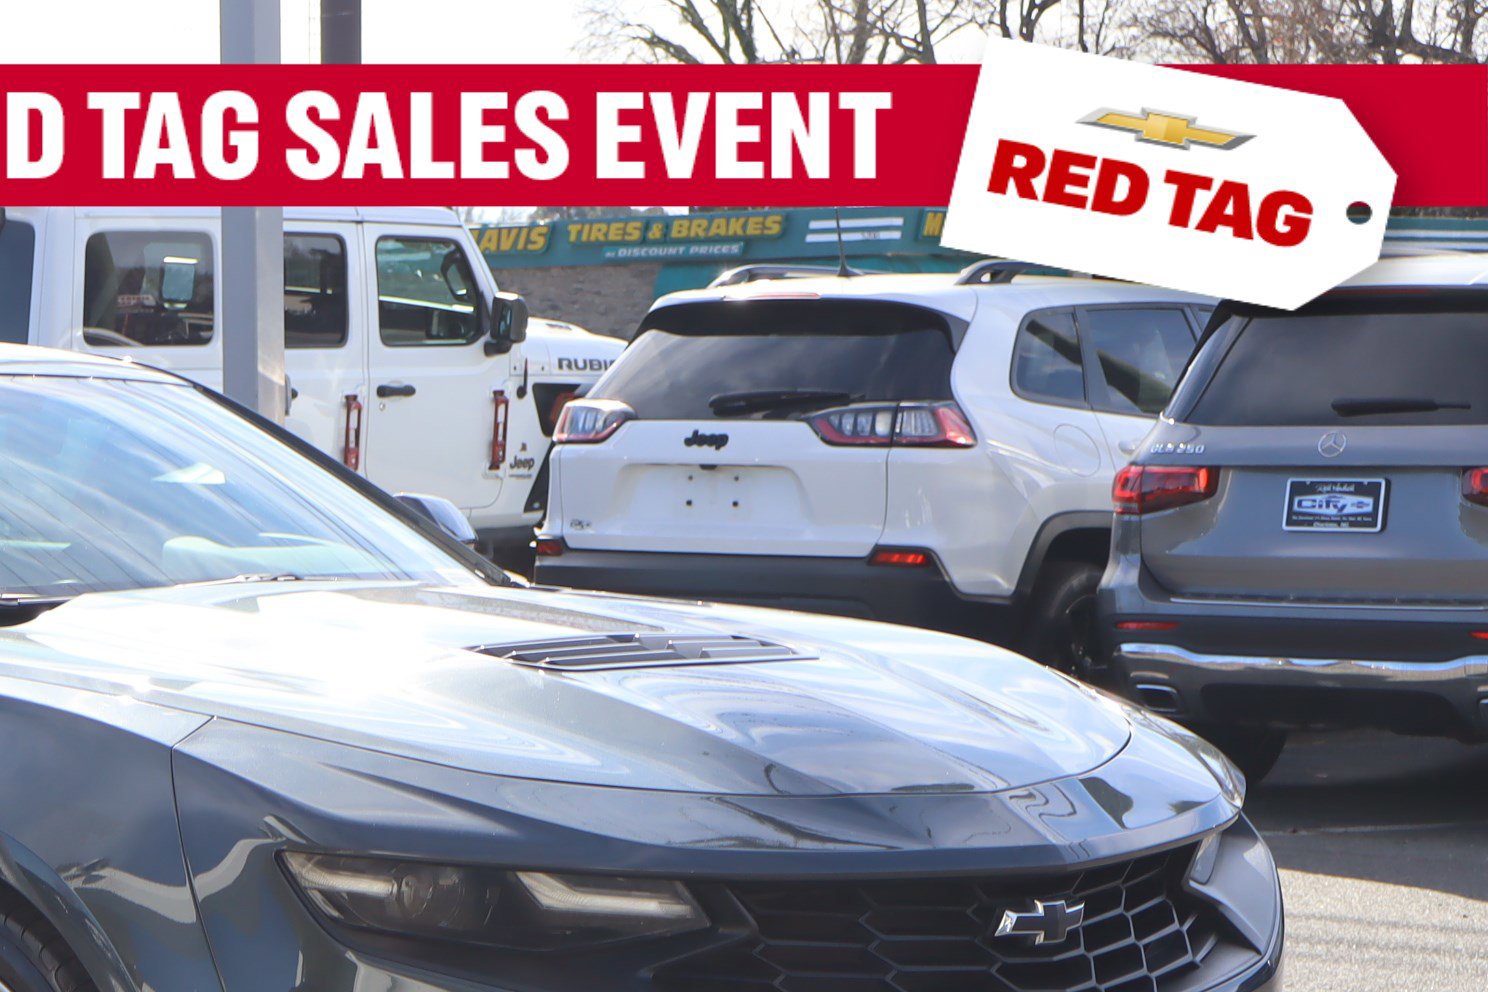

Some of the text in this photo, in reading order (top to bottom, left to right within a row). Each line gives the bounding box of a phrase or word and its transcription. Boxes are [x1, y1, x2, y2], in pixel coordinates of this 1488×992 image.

[567, 215, 782, 242] TIRES & BRAKES
[618, 246, 686, 258] DISCOUNT
[688, 244, 741, 255] PRICES
[683, 429, 729, 450] Jeep
[510, 455, 535, 471] Jeep
[1297, 499, 1348, 513] City
